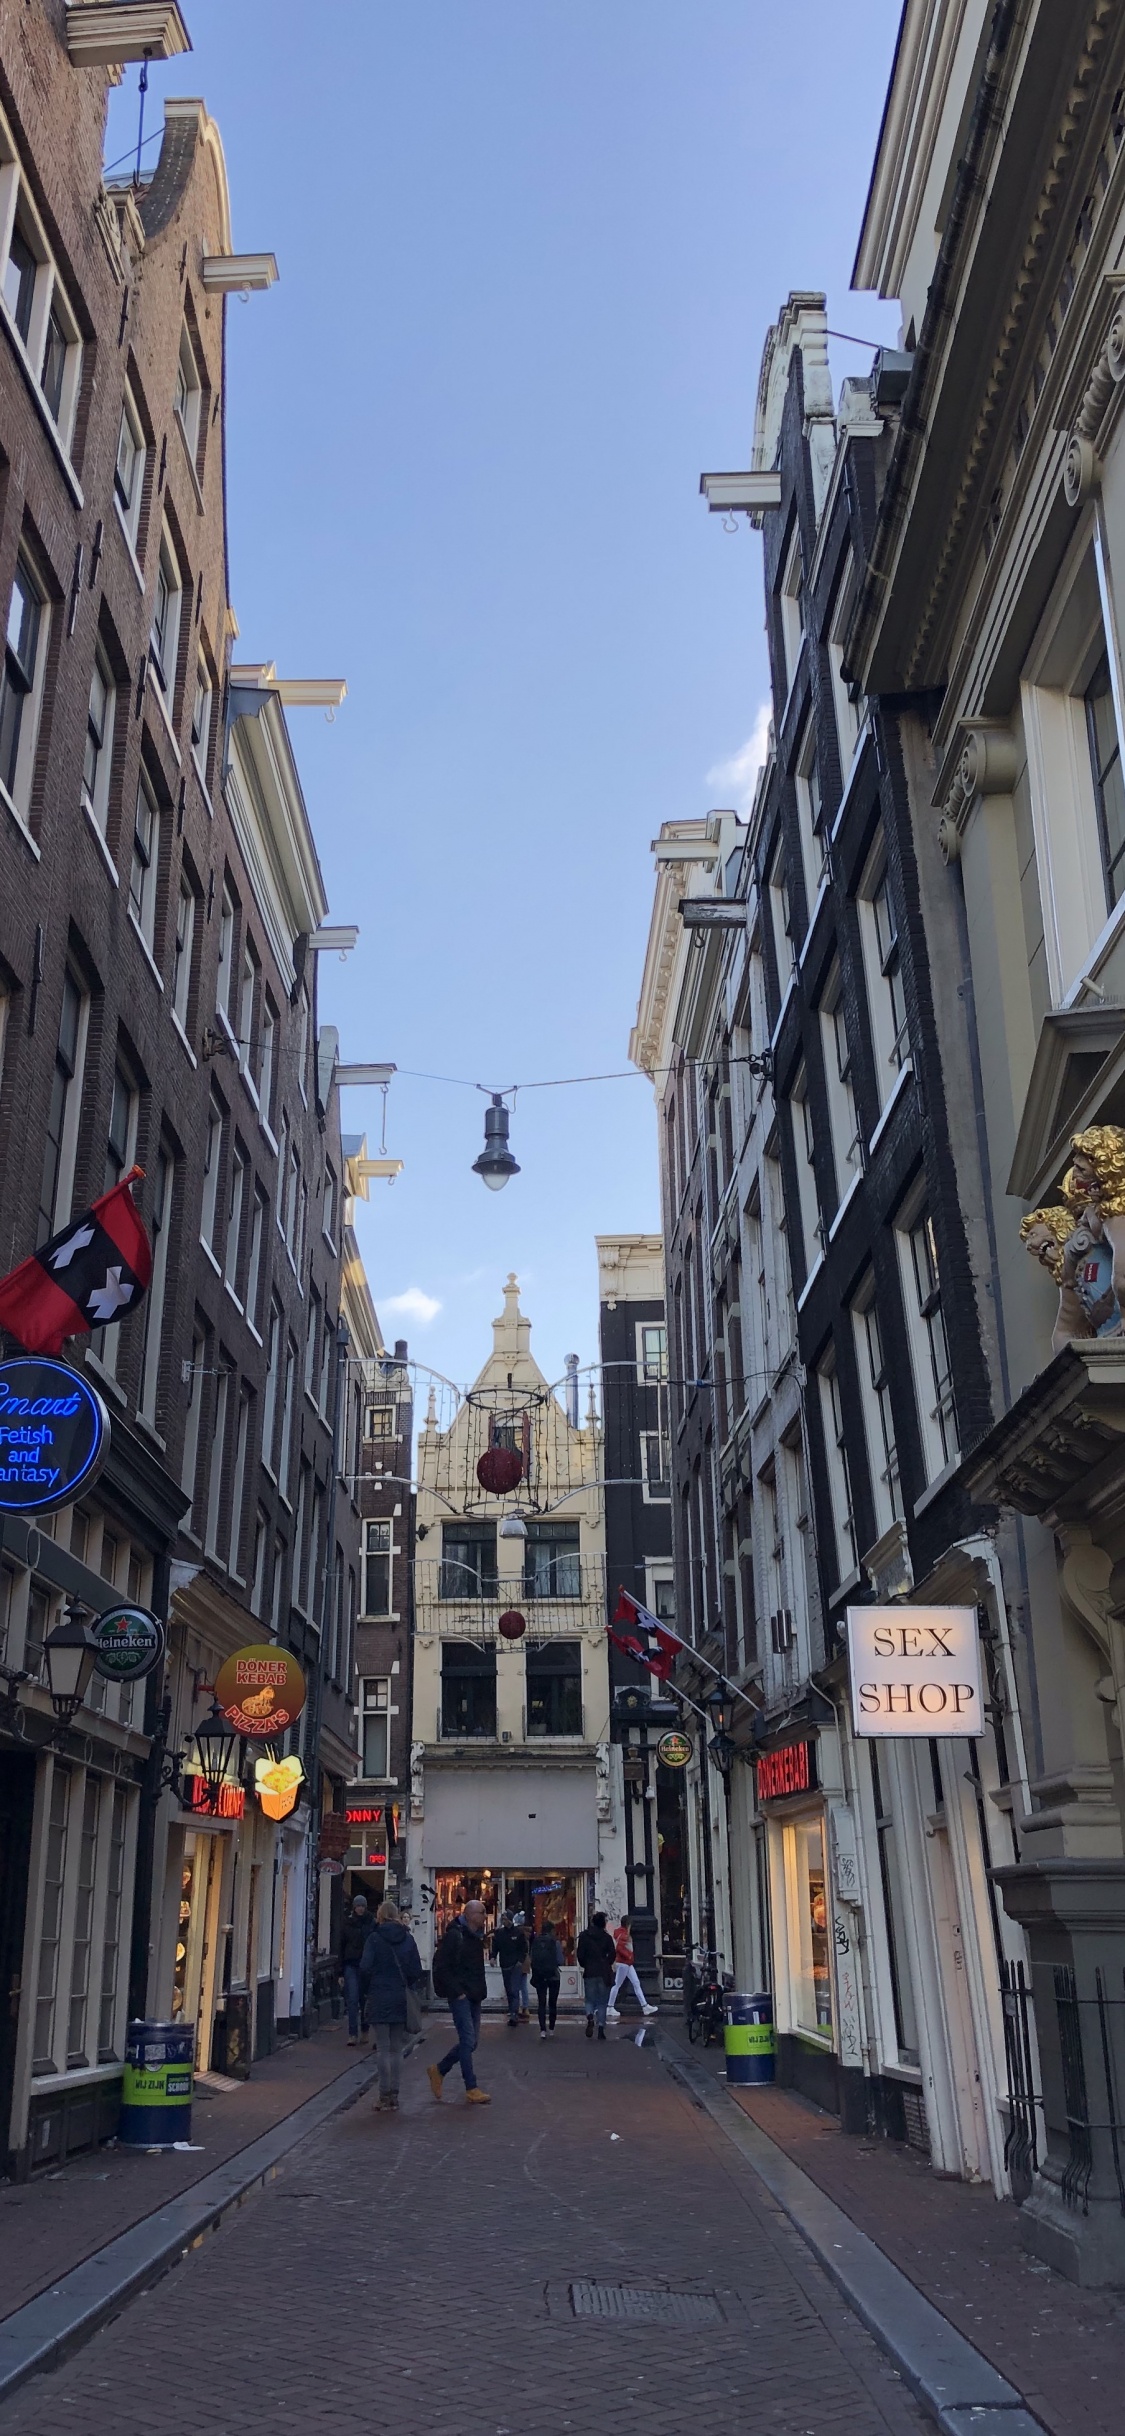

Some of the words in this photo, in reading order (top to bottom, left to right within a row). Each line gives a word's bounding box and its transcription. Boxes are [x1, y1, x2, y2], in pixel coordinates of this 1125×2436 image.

[0, 1425, 53, 1445] Fetish
[9, 1447, 39, 1463] and
[97, 1636, 152, 1649] Heineken
[874, 1628, 956, 1657] SEX
[237, 1658, 287, 1673] DÖNER
[237, 1672, 286, 1685] KEBAB
[859, 1683, 974, 1713] SHOP
[225, 1705, 289, 1733] PIZZA'S
[661, 1744, 690, 1752] Heineken
